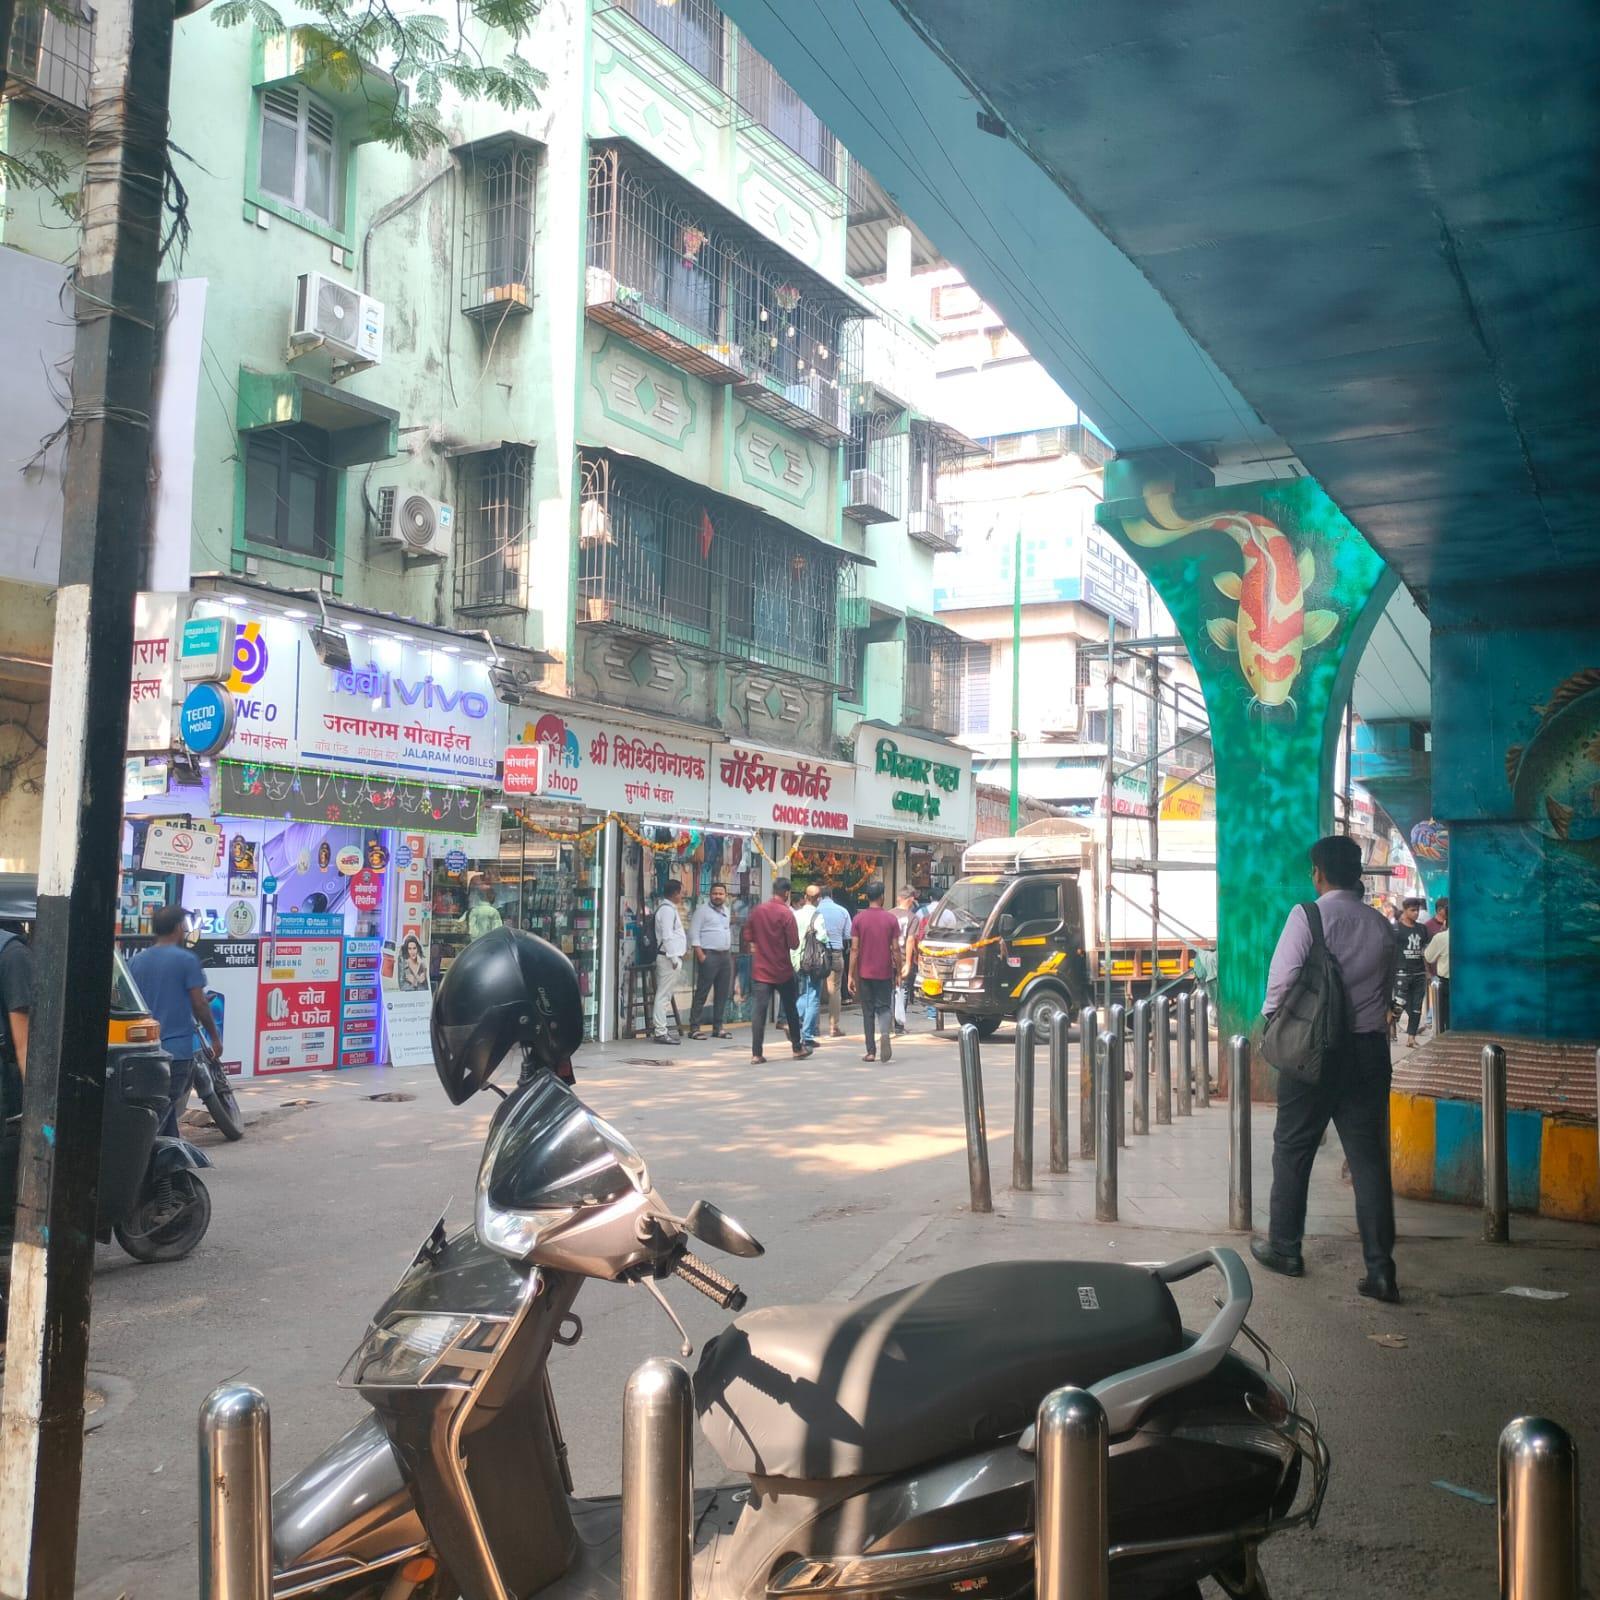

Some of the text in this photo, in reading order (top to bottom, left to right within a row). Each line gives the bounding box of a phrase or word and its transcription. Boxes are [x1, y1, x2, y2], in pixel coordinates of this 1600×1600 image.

[393, 675, 489, 719] vivo
[186, 705, 216, 722] TECNO
[323, 714, 472, 751] जलाराम मोबाईल
[402, 747, 494, 769] JALARAM MOBILES
[589, 732, 609, 768] श्री
[547, 769, 578, 795] shop
[720, 750, 832, 801] चॉईस कॉर्नर
[772, 804, 810, 827] CHOICE
[811, 809, 849, 831] CORNER
[233, 911, 248, 919] 4.9
[214, 943, 256, 955] जलाराम
[298, 987, 326, 1005] लोन
[291, 1007, 331, 1025] पे फोन
